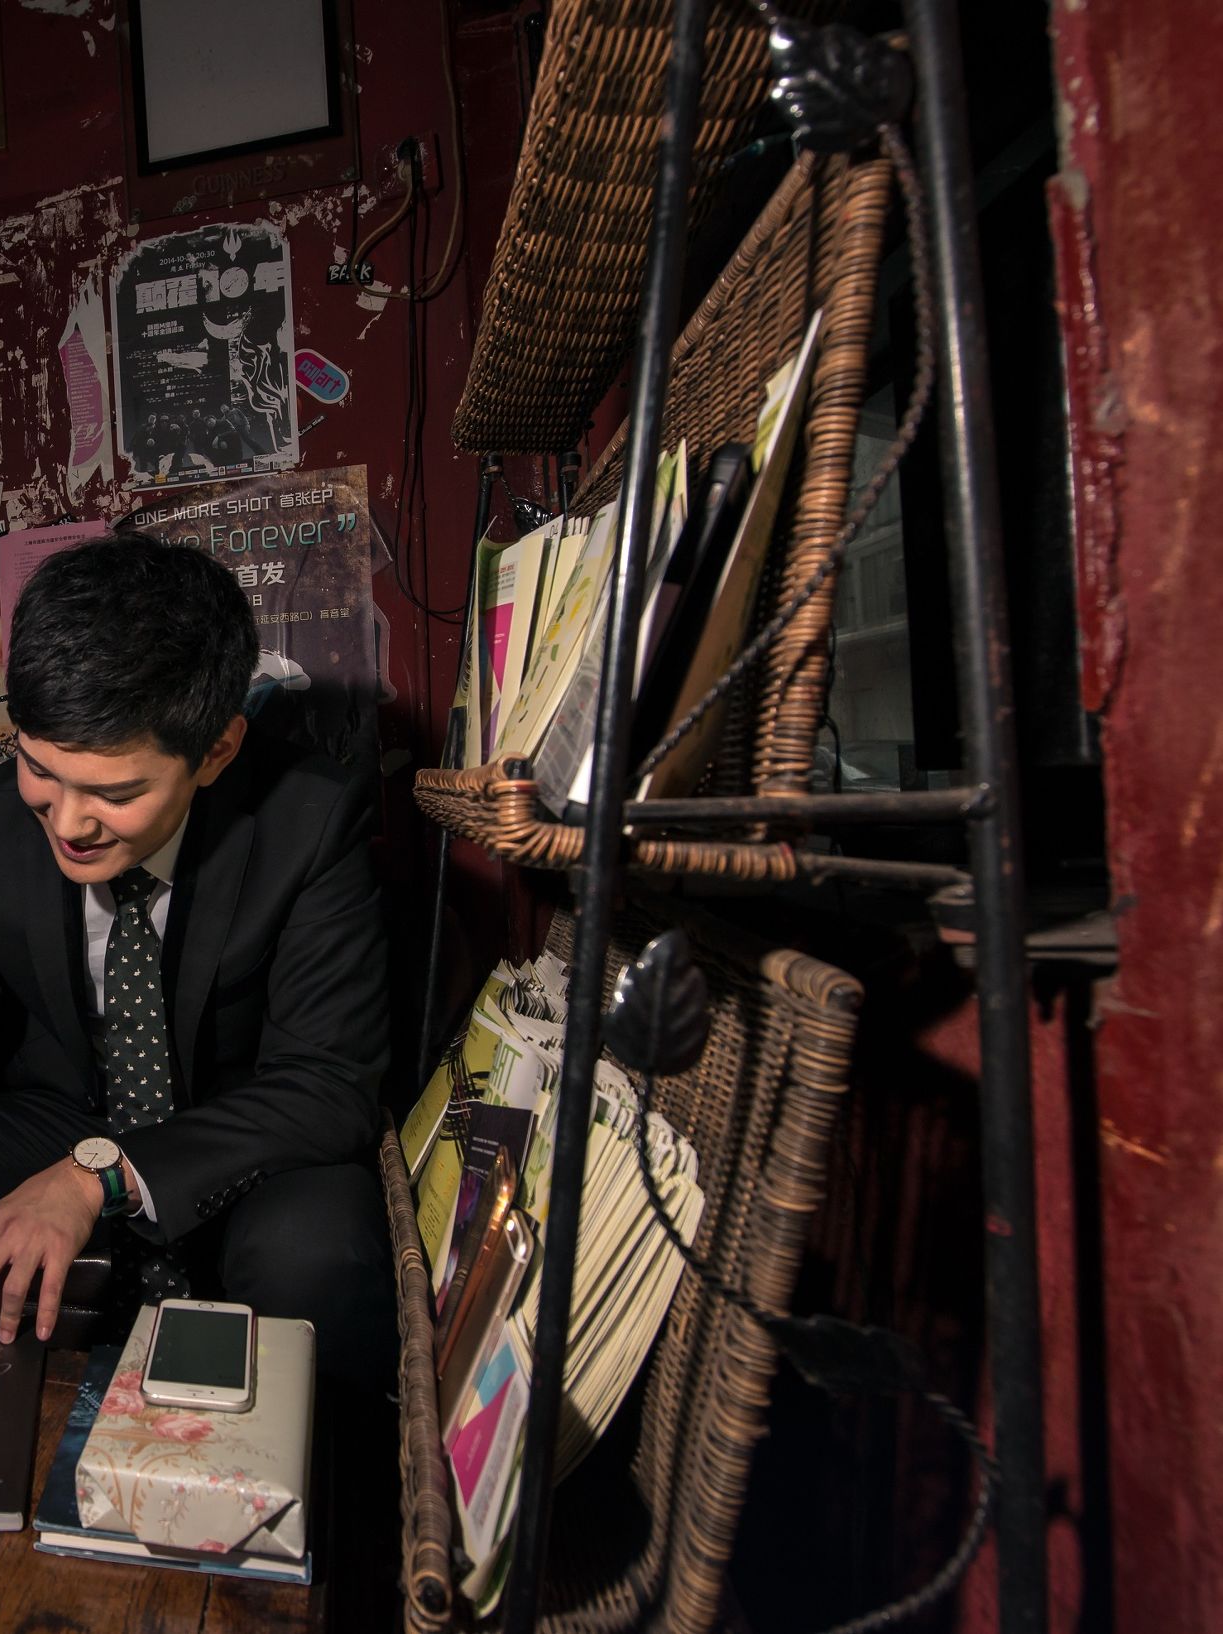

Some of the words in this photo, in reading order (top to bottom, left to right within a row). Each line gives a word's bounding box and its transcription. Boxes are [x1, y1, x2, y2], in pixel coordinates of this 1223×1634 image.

[193, 164, 287, 196] GUINNESS
[328, 263, 372, 281] BAK
[135, 508, 168, 525] ONE
[173, 502, 220, 520] MORE
[226, 496, 272, 514] SHOT
[280, 488, 333, 508] 首张EP
